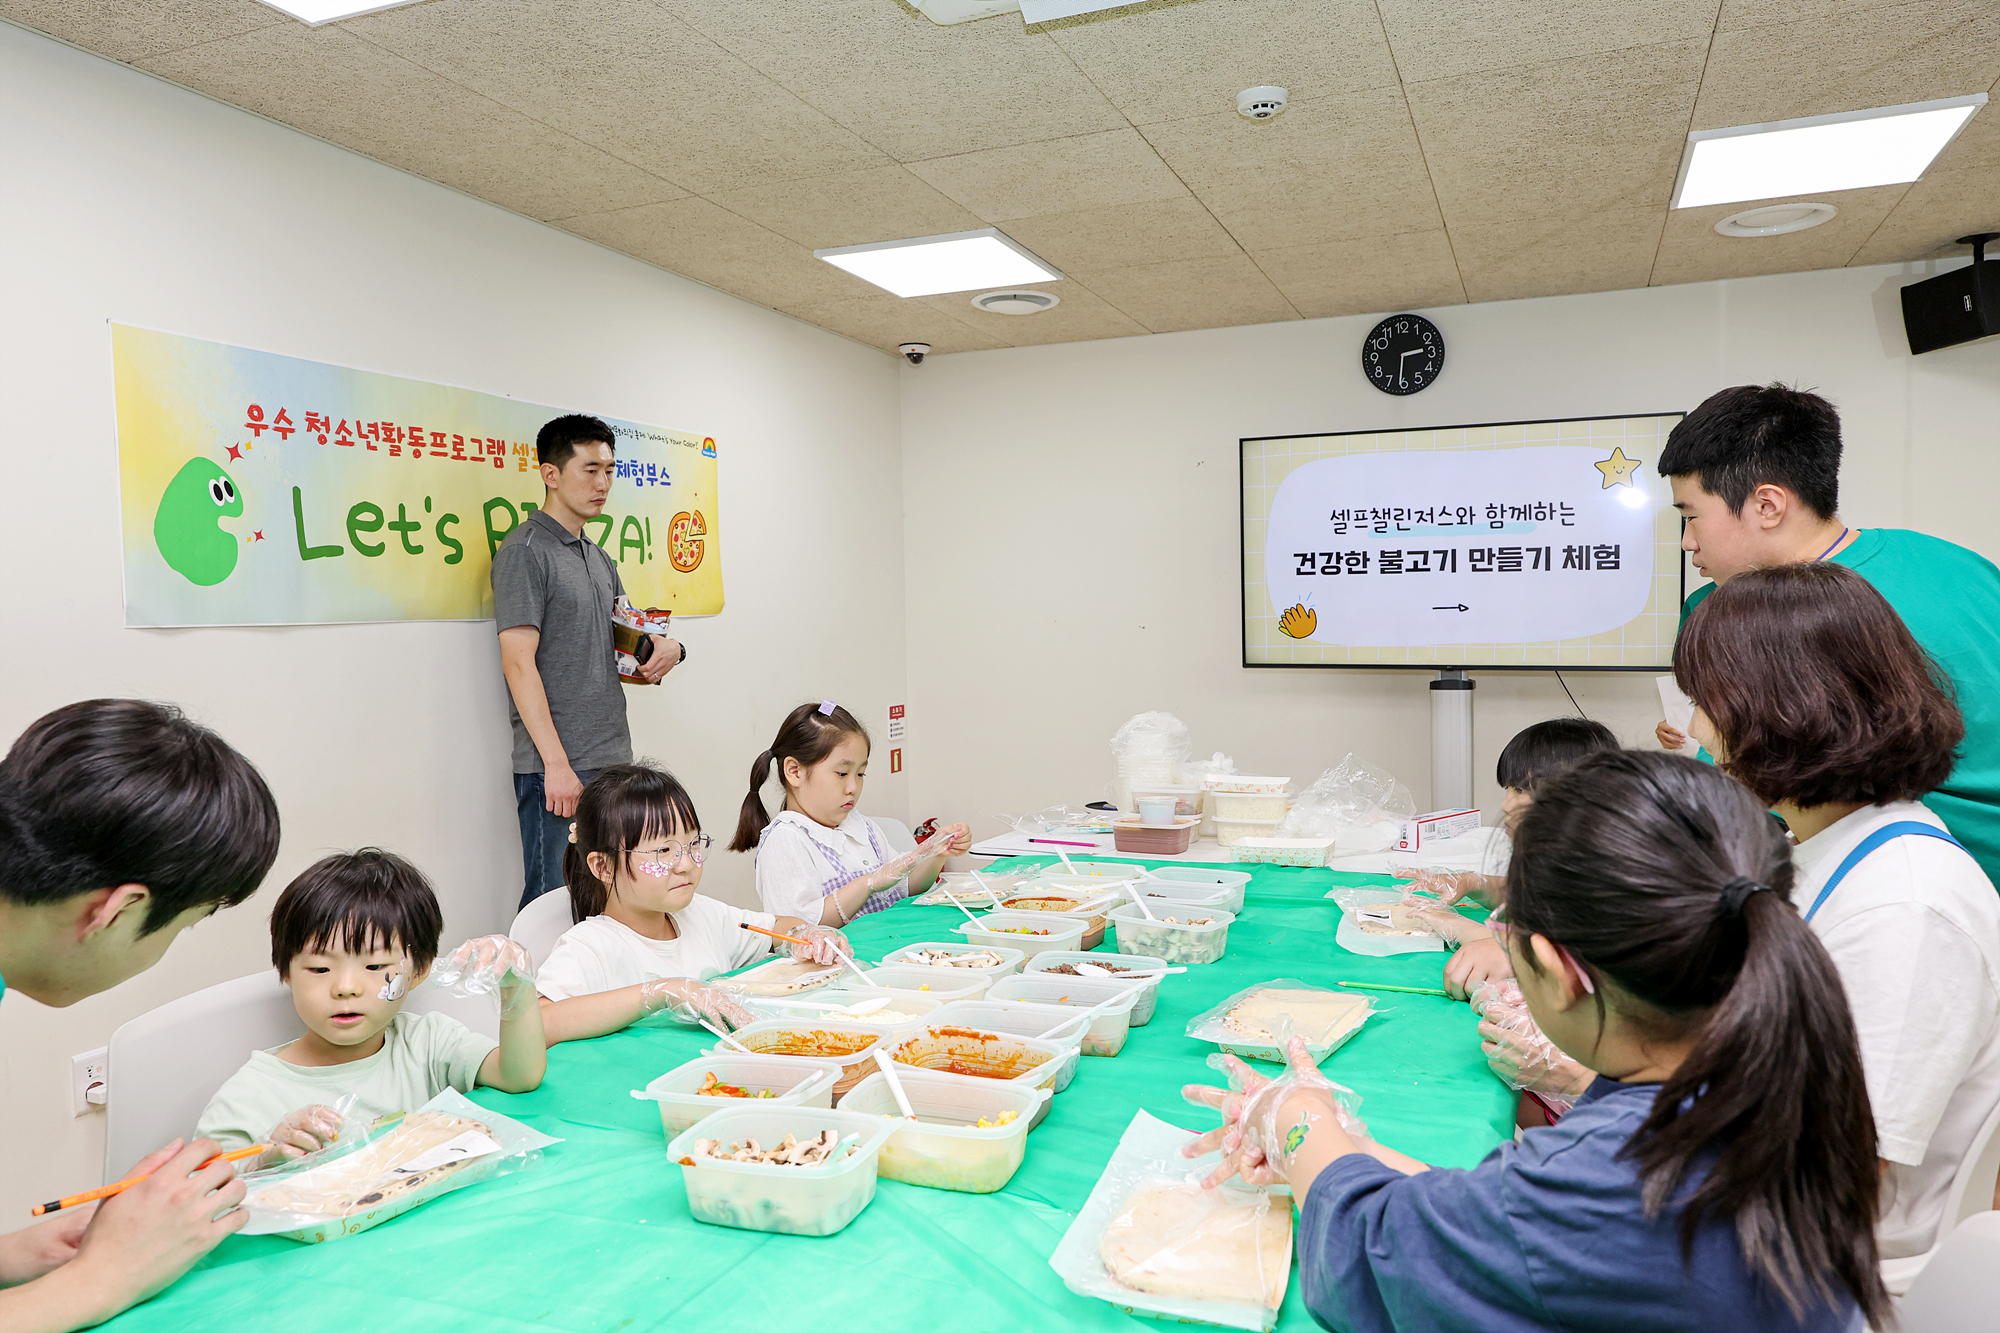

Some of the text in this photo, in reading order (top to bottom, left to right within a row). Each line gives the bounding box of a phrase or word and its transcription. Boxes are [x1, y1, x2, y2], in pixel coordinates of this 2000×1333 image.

[1382, 326, 1392, 339] 11
[1394, 321, 1409, 334] 12
[1413, 323, 1419, 336] 1
[1371, 337, 1389, 350] 10
[1422, 332, 1432, 345] 2
[1427, 345, 1436, 358] 3
[1370, 352, 1379, 365] 9
[1374, 365, 1383, 378] 8
[1424, 360, 1433, 372] 4
[1385, 374, 1393, 387] 7
[1400, 377, 1409, 389] 6
[1414, 371, 1423, 384] 5
[244, 403, 297, 441] 우수
[305, 410, 506, 469] 청소년활동프로그램
[1330, 501, 1576, 535] 셀프챌린저스와 함께하는
[292, 485, 653, 568] Let's PZA!
[1293, 544, 1621, 576] 건강한 불고기 만들기 체험
